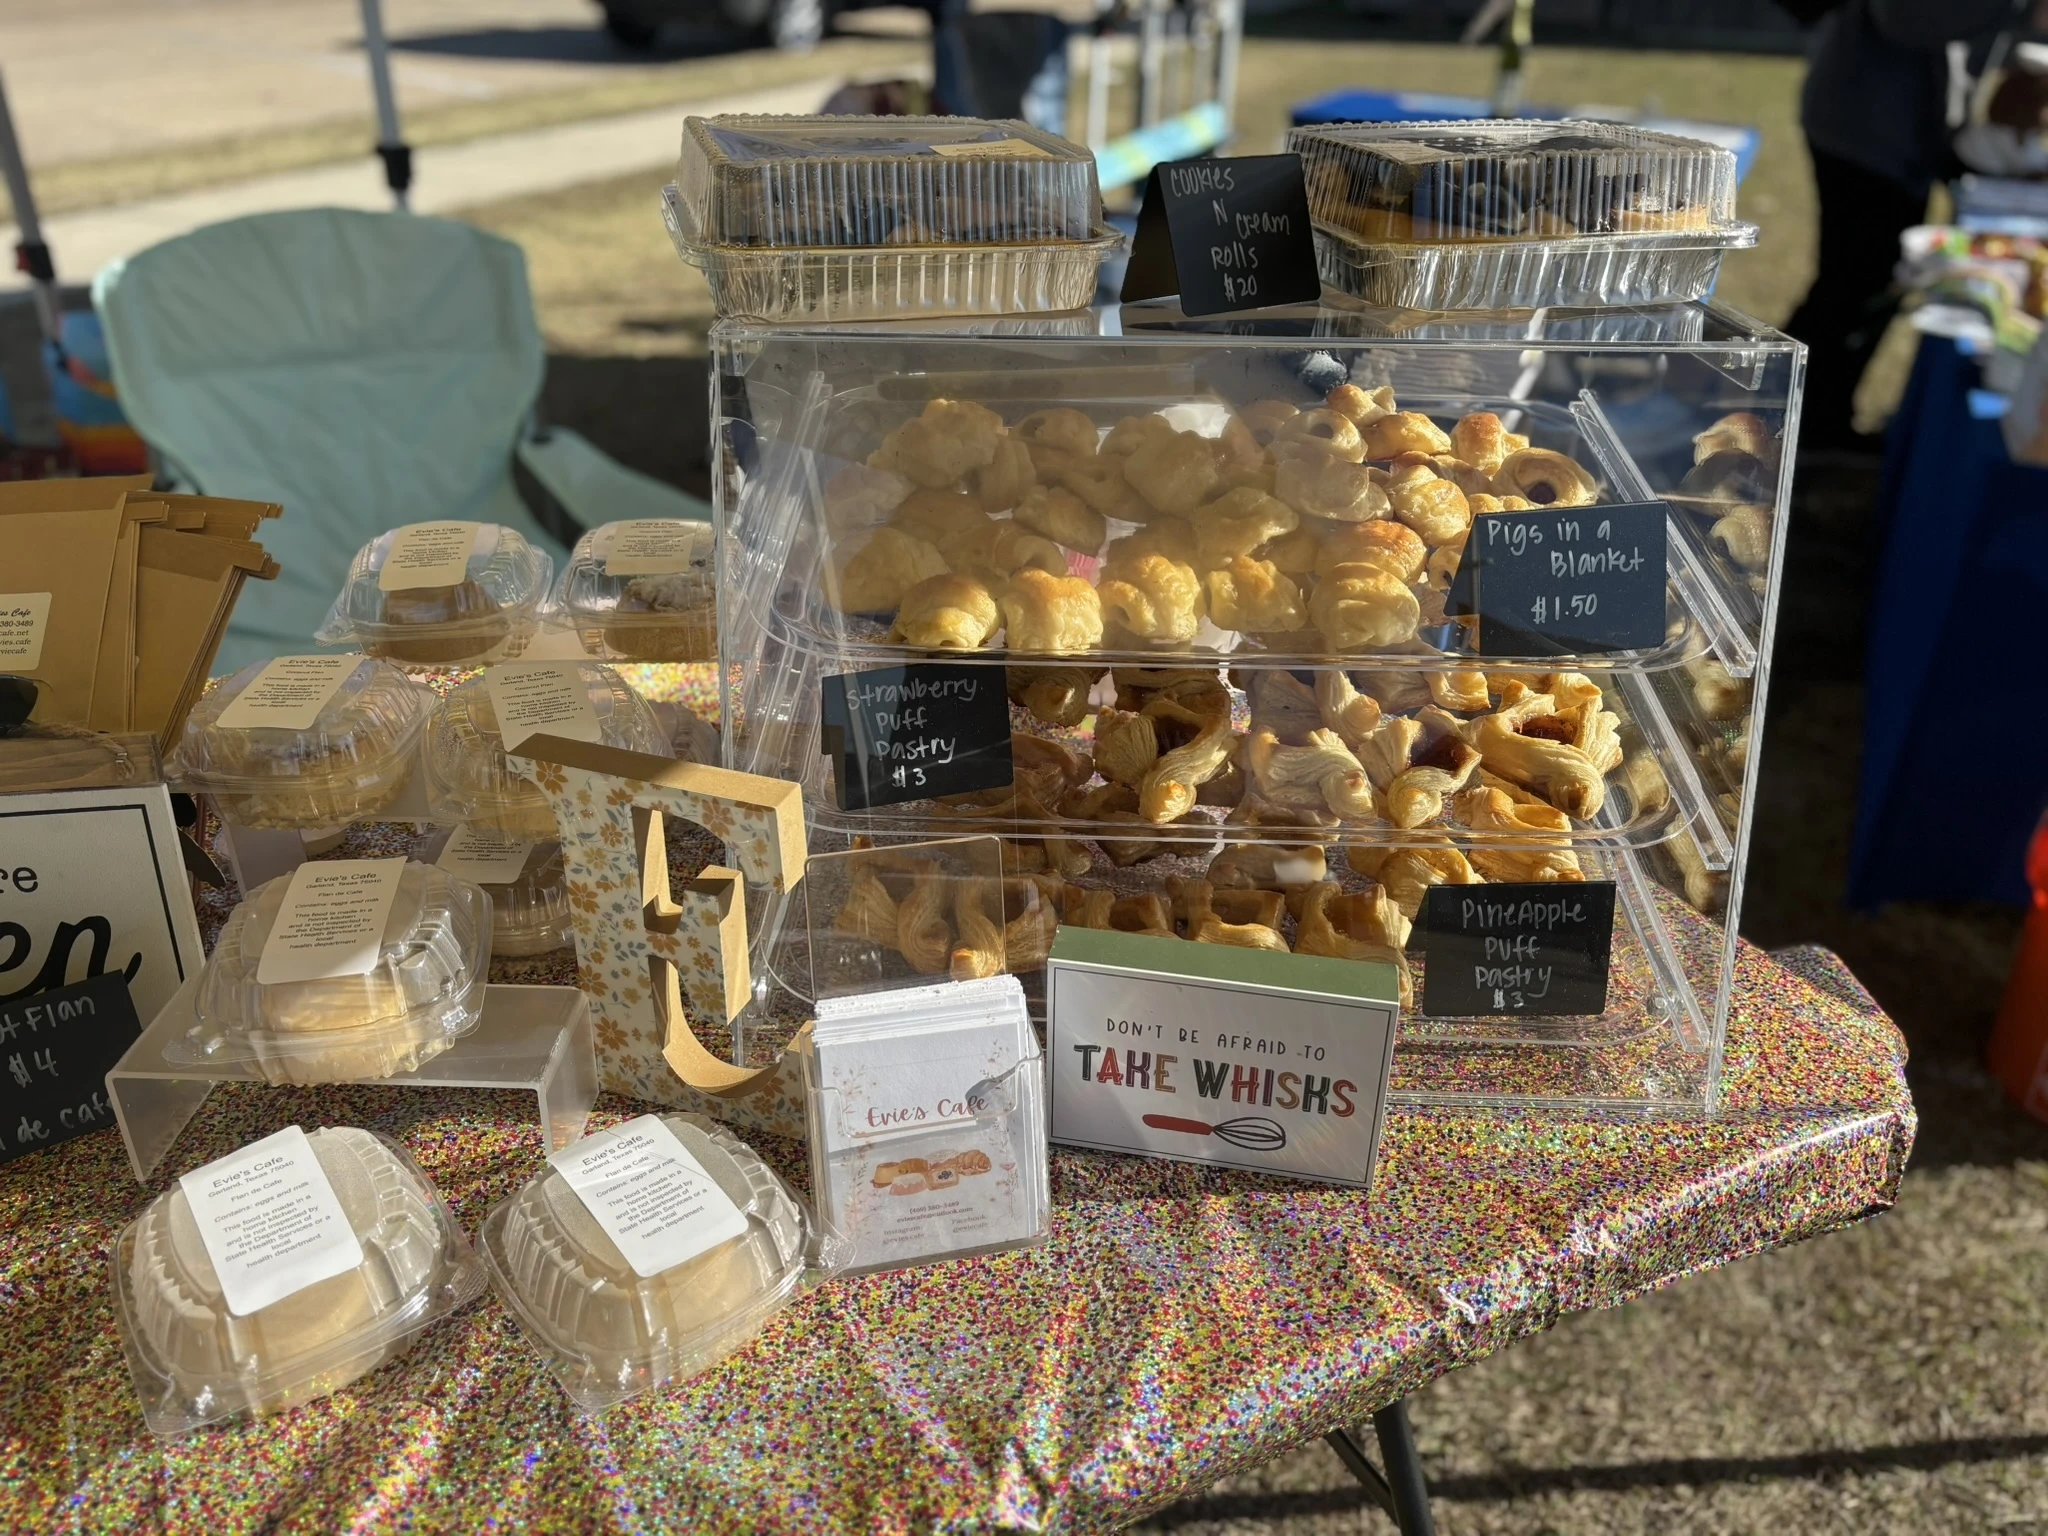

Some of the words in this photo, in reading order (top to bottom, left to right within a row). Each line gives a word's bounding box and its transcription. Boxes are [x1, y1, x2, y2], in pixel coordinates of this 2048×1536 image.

[1212, 198, 1228, 226] N
[1224, 272, 1258, 302] $20
[1487, 518, 1544, 556] Pigs
[1556, 517, 1580, 542] in
[1597, 519, 1611, 541] a
[1550, 546, 1645, 578] Blanket
[1530, 593, 1598, 624] $1.50
[25, 996, 96, 1032] Flan
[1106, 1018, 1164, 1039] DON'T
[1179, 1027, 1200, 1044] BE
[1217, 1033, 1286, 1055] AFRAID
[1305, 1044, 1326, 1061] TO
[8, 1048, 59, 1088] $4
[1073, 1043, 1178, 1093] TAKE
[1192, 1058, 1358, 1118] WHISKS
[866, 1106, 930, 1128] Evie's
[937, 1096, 990, 1118] Cafe
[17, 1116, 50, 1144] de
[581, 1159, 612, 1174] Garland,
[611, 1149, 632, 1160] Texas
[632, 1138, 654, 1150] 75040
[582, 1148, 615, 1165] Evie's
[616, 1135, 642, 1149] Cafe
[208, 1181, 243, 1197] Garland,
[244, 1171, 268, 1182] Texas
[269, 1160, 294, 1173] 75040
[212, 1169, 250, 1187] Evie's
[253, 1156, 283, 1171] Cafe
[595, 1179, 628, 1197] Contains:
[629, 1171, 647, 1182] eggs
[647, 1163, 661, 1173] and
[661, 1157, 676, 1166] milk
[604, 1168, 621, 1178] Flan
[631, 1155, 649, 1165] Cafe
[214, 1204, 252, 1222] Contains:
[254, 1195, 274, 1206] eggs
[276, 1187, 291, 1198] and
[292, 1181, 309, 1191] milk
[230, 1192, 249, 1202] Flan
[262, 1179, 282, 1188] Cafe
[607, 1197, 624, 1207] This
[623, 1189, 640, 1199] food
[648, 1176, 668, 1188] made
[615, 1210, 629, 1219] and
[637, 1200, 650, 1209] not
[649, 1184, 683, 1202] inspected
[626, 1194, 647, 1206] home
[646, 1182, 672, 1196] kitchen
[222, 1223, 241, 1232] This
[242, 1214, 261, 1225] food
[271, 1201, 294, 1213] made
[242, 1220, 266, 1232] home
[267, 1207, 297, 1222] kitchen
[618, 1222, 638, 1234] State
[638, 1210, 662, 1224] Health
[662, 1195, 692, 1212] Services
[627, 1213, 640, 1221] the
[640, 1193, 681, 1215] Department
[641, 1226, 664, 1239] health
[664, 1205, 704, 1227] department
[659, 1210, 677, 1222] local
[224, 1249, 247, 1262] State
[248, 1237, 276, 1251] Health
[277, 1222, 313, 1239] Services
[226, 1236, 242, 1246] and
[252, 1226, 266, 1235] not
[267, 1209, 307, 1229] inspected
[238, 1240, 252, 1248] the
[254, 1219, 302, 1242] Department
[246, 1254, 272, 1268] health
[274, 1233, 321, 1256] department
[270, 1238, 291, 1250] local
